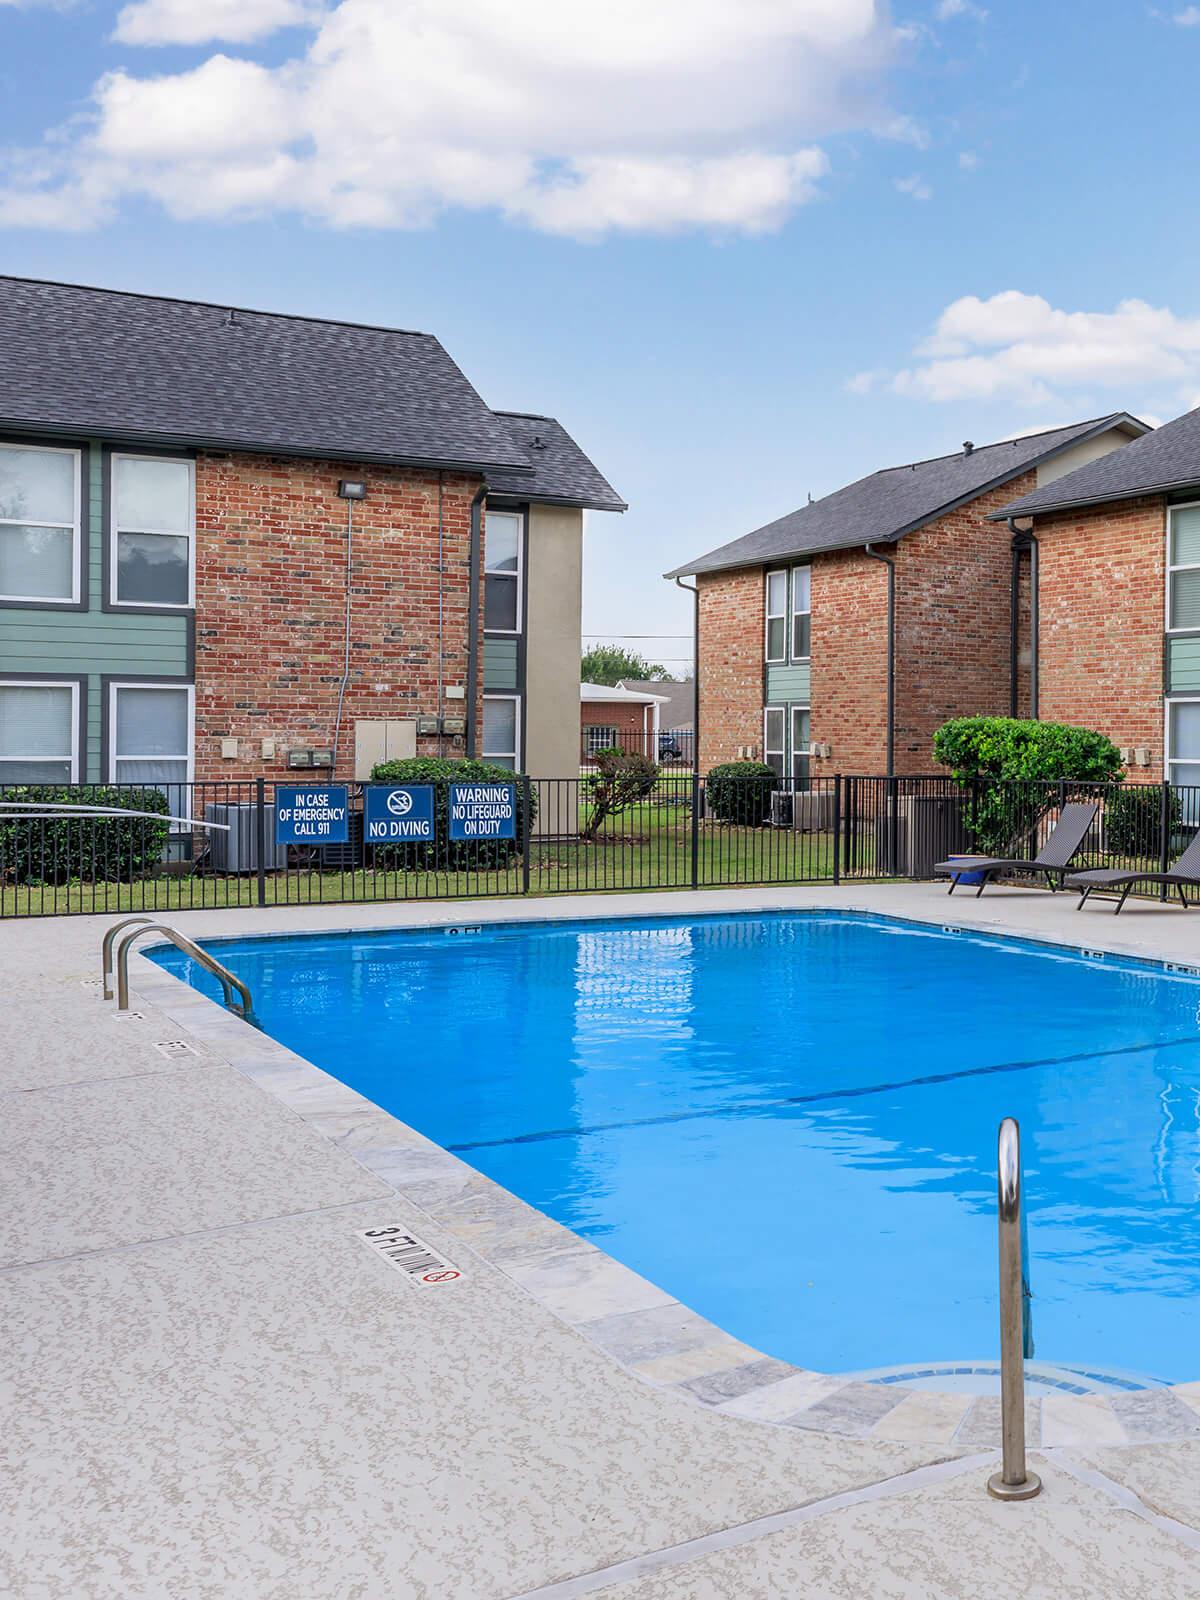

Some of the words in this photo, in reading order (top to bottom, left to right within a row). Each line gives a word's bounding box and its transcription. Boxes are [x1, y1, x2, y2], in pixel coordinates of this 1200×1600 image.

[295, 795, 305, 807] IN
[306, 794, 329, 806] CASE
[455, 788, 509, 803] WARNING
[279, 809, 292, 821] OF
[293, 807, 345, 821] EMERGENCY
[452, 805, 466, 820] NO
[467, 804, 512, 820] LIFEGUARD
[294, 823, 316, 836] CALL
[317, 822, 330, 835] 911
[369, 822, 387, 837] NO
[388, 820, 430, 836] DIVING
[464, 821, 477, 835] ON
[478, 820, 501, 834] DUTY
[364, 1227, 401, 1238] 3
[372, 1235, 417, 1250] FT
